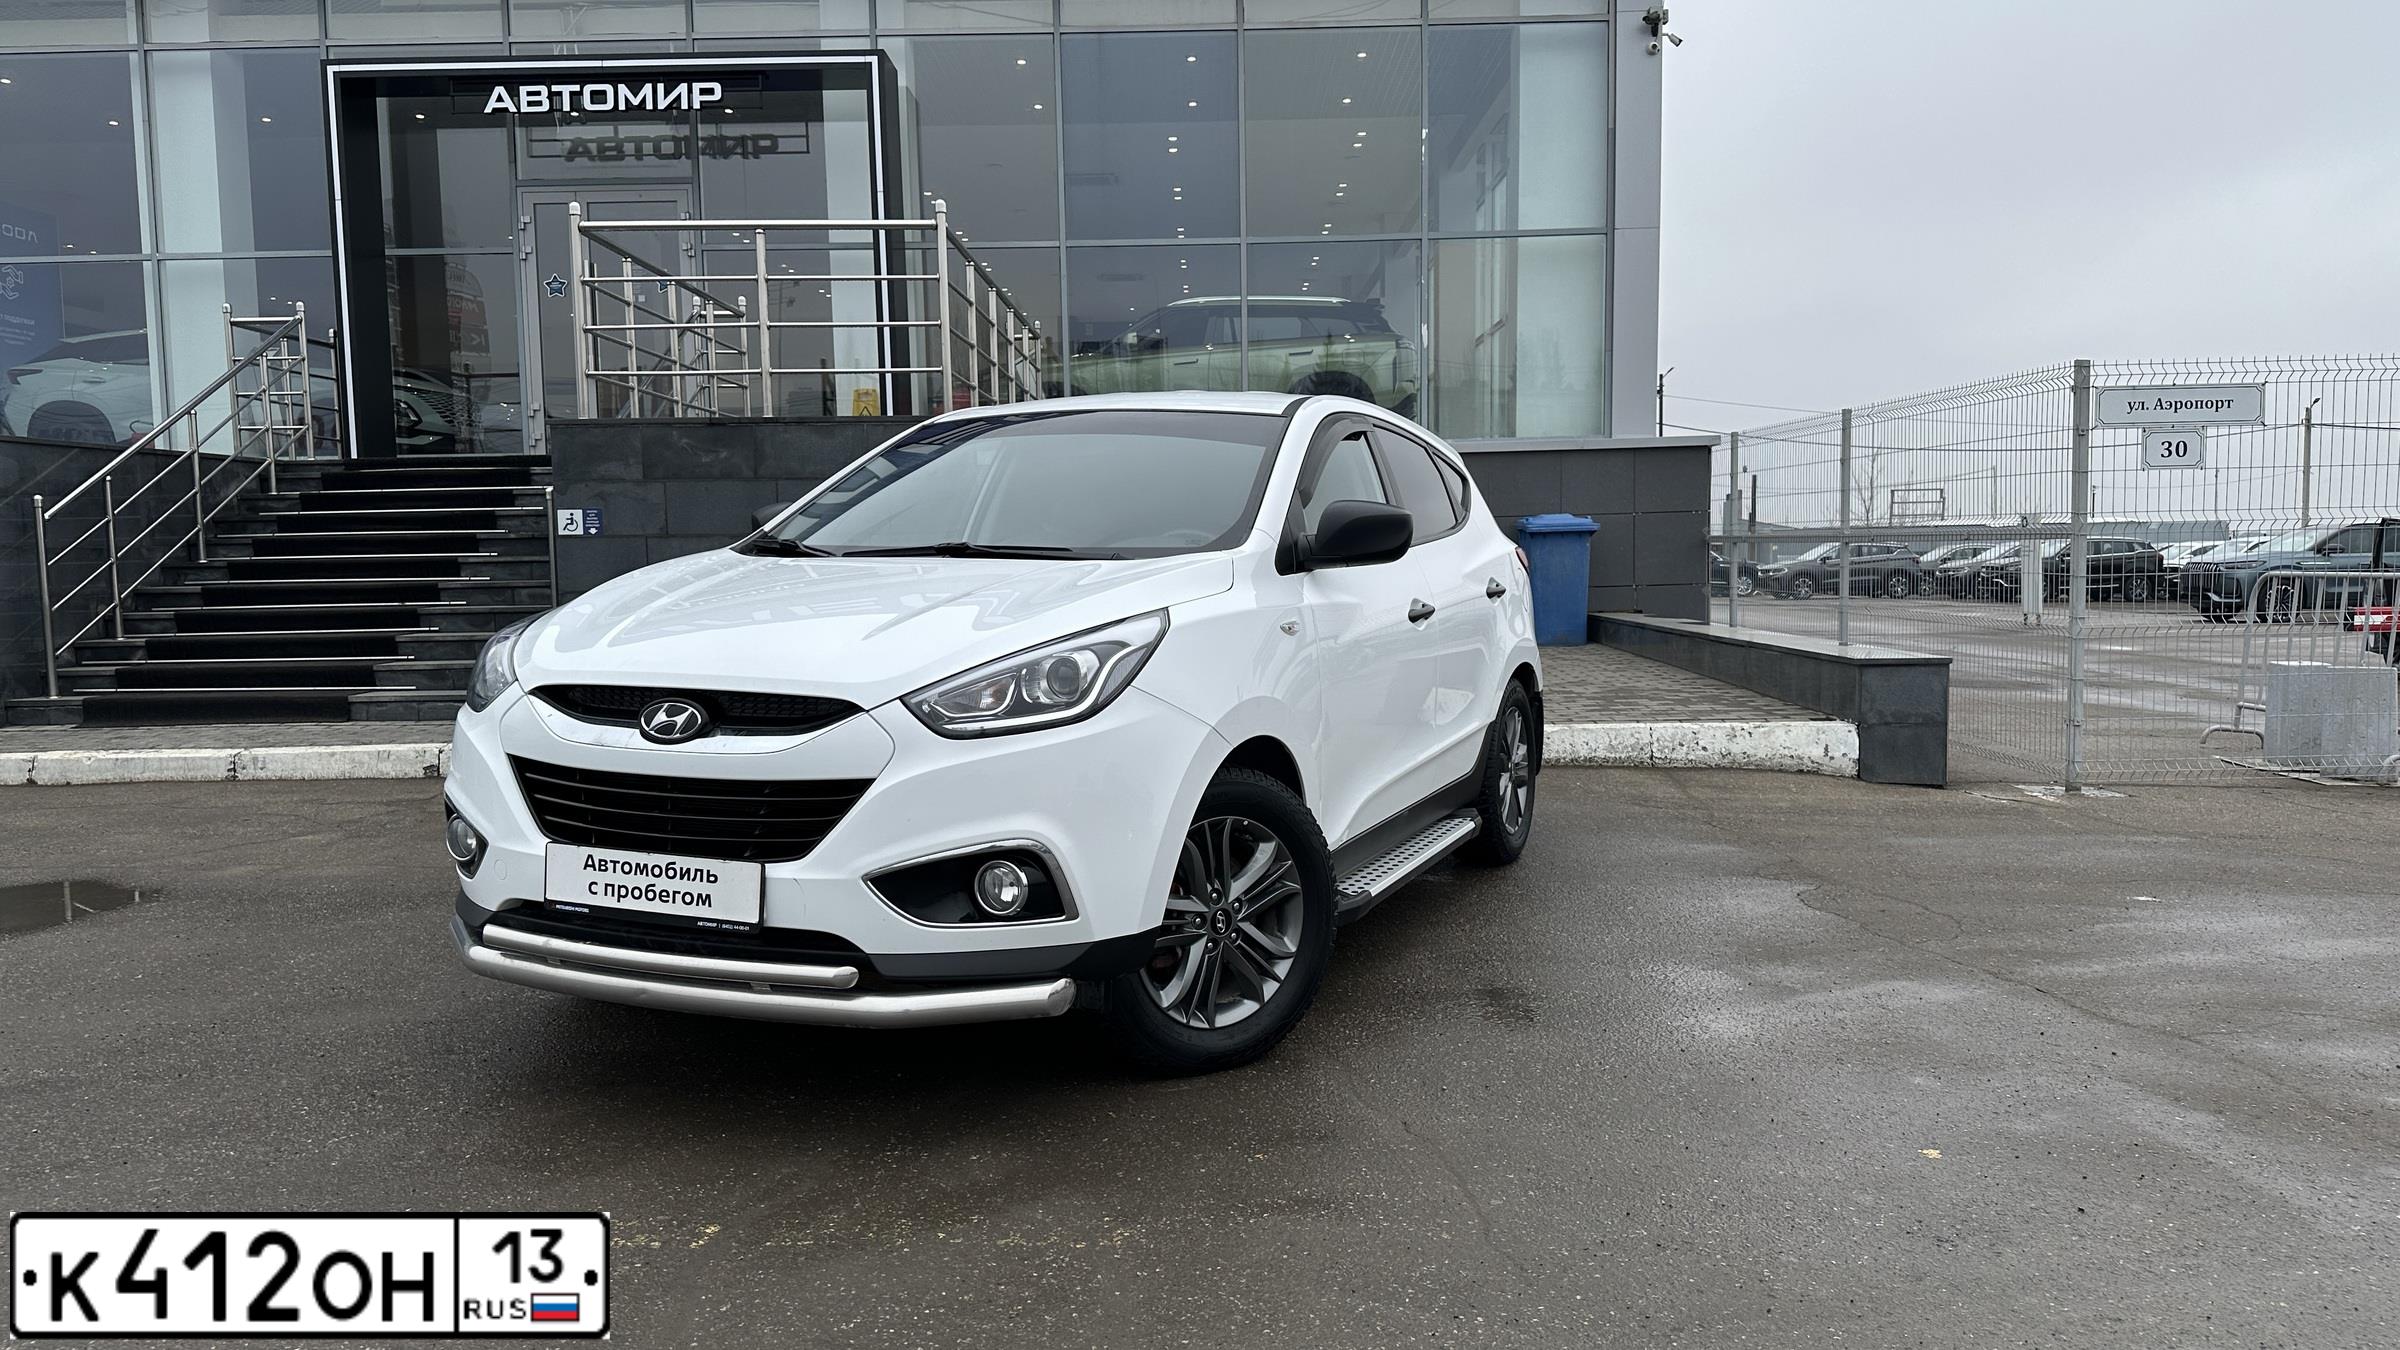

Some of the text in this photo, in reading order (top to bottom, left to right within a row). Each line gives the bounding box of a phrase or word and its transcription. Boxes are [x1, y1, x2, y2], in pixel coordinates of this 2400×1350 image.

[483, 82, 722, 113] АВТОМИР
[2127, 398, 2234, 414] ул. Аэропорт
[2160, 440, 2188, 458] 30
[583, 854, 718, 884] Автомобиль
[588, 881, 712, 908] с пробегом
